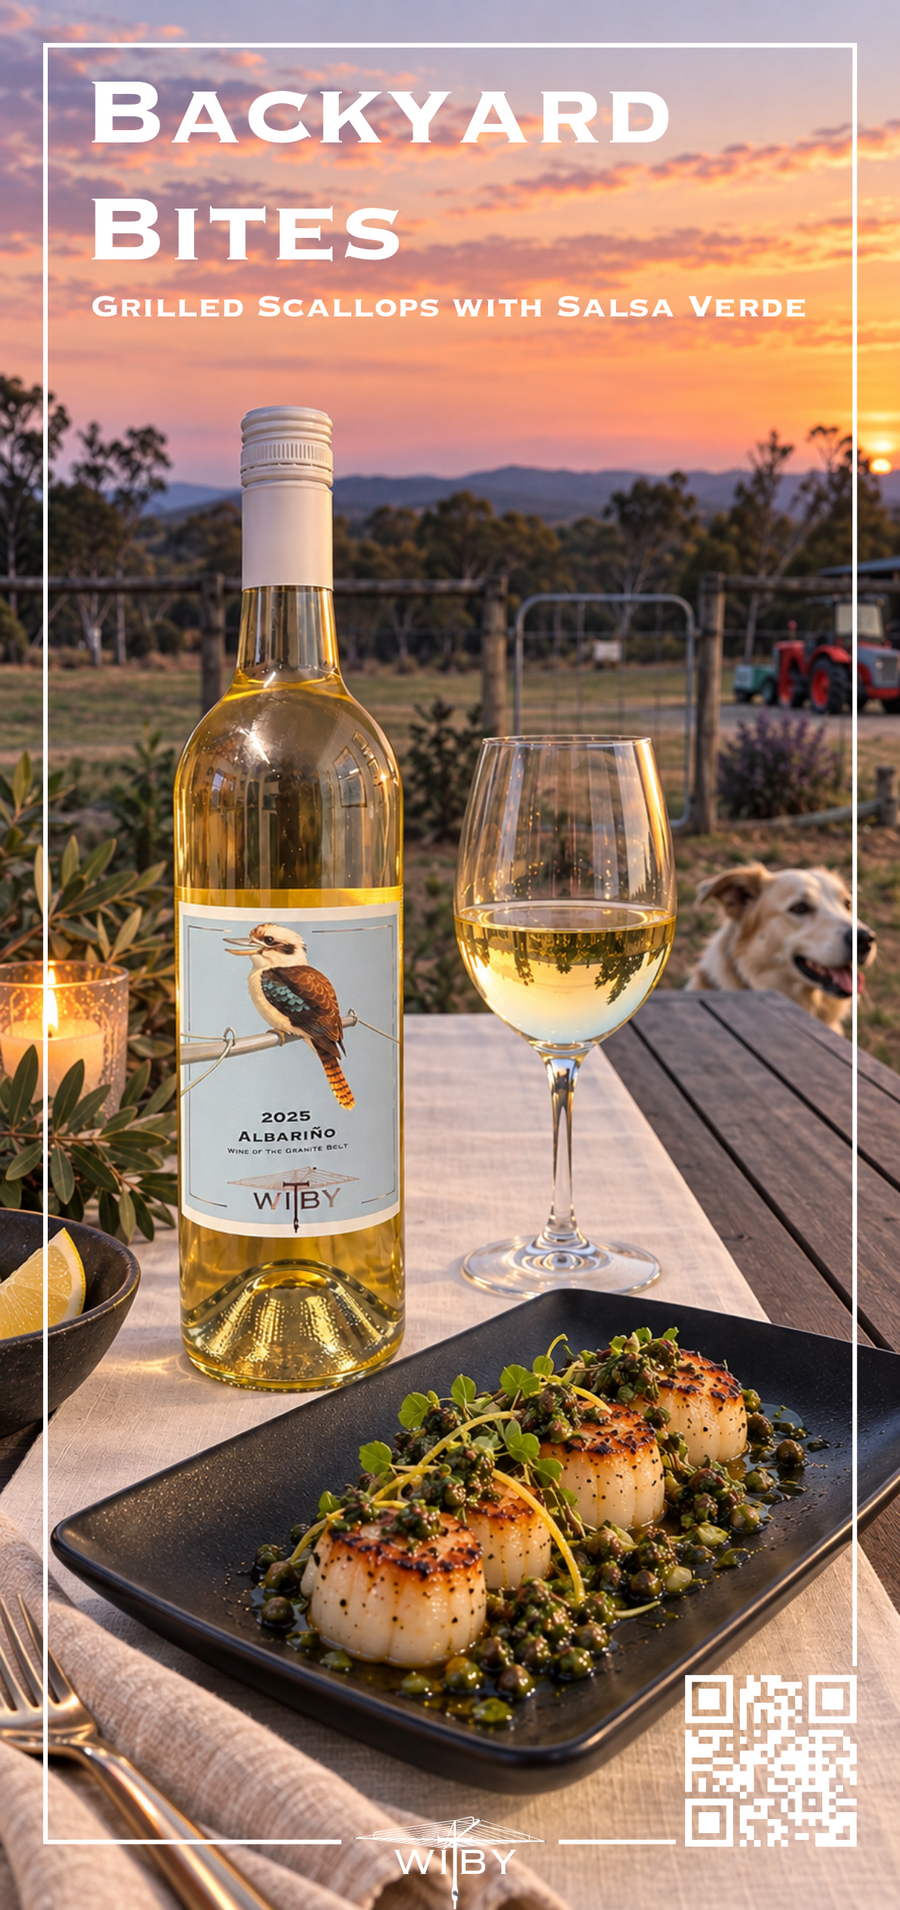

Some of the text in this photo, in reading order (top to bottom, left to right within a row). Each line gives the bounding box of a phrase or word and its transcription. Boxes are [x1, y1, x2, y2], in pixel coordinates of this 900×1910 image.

[261, 1110, 311, 1123] 2025
[238, 1126, 336, 1143] ALBARIÑO
[285, 1145, 323, 1154] GRANITE
